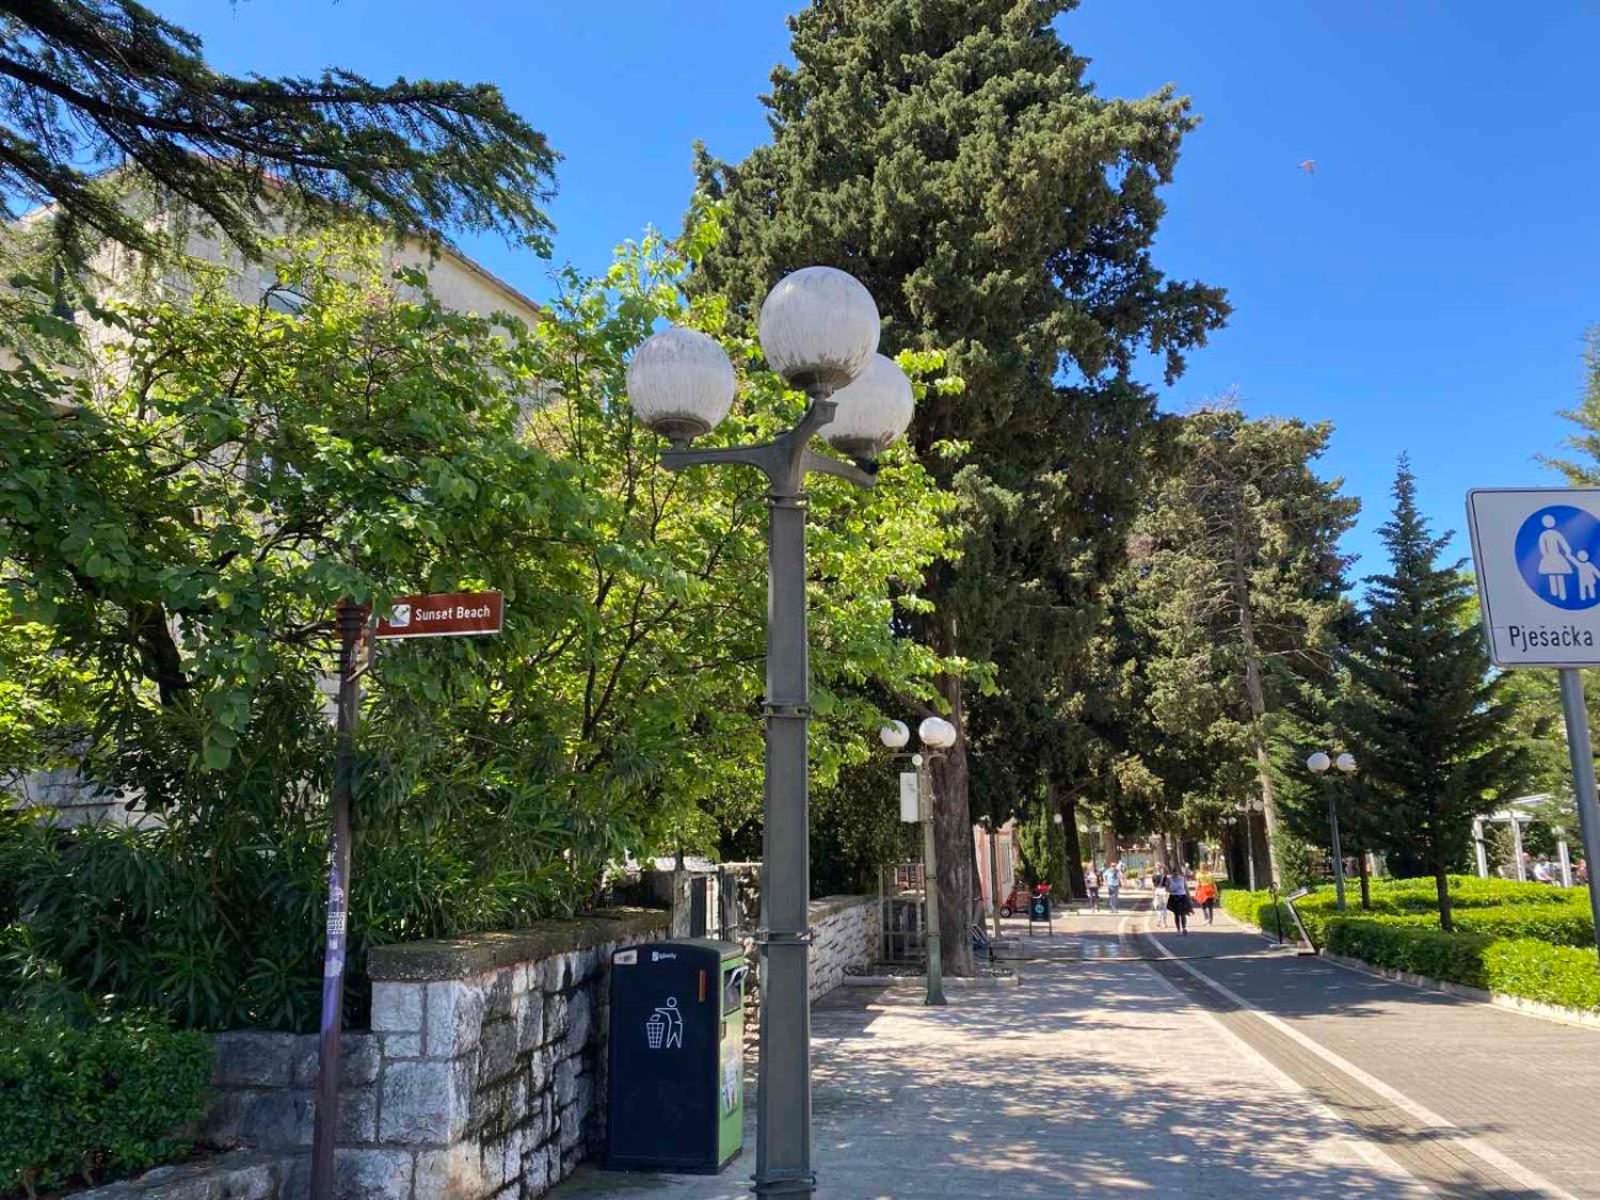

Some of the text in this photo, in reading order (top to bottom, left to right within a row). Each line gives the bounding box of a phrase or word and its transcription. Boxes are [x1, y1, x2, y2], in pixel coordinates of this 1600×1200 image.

[415, 605, 490, 621] Sunset Beach
[1509, 625, 1593, 652] Pješačka
